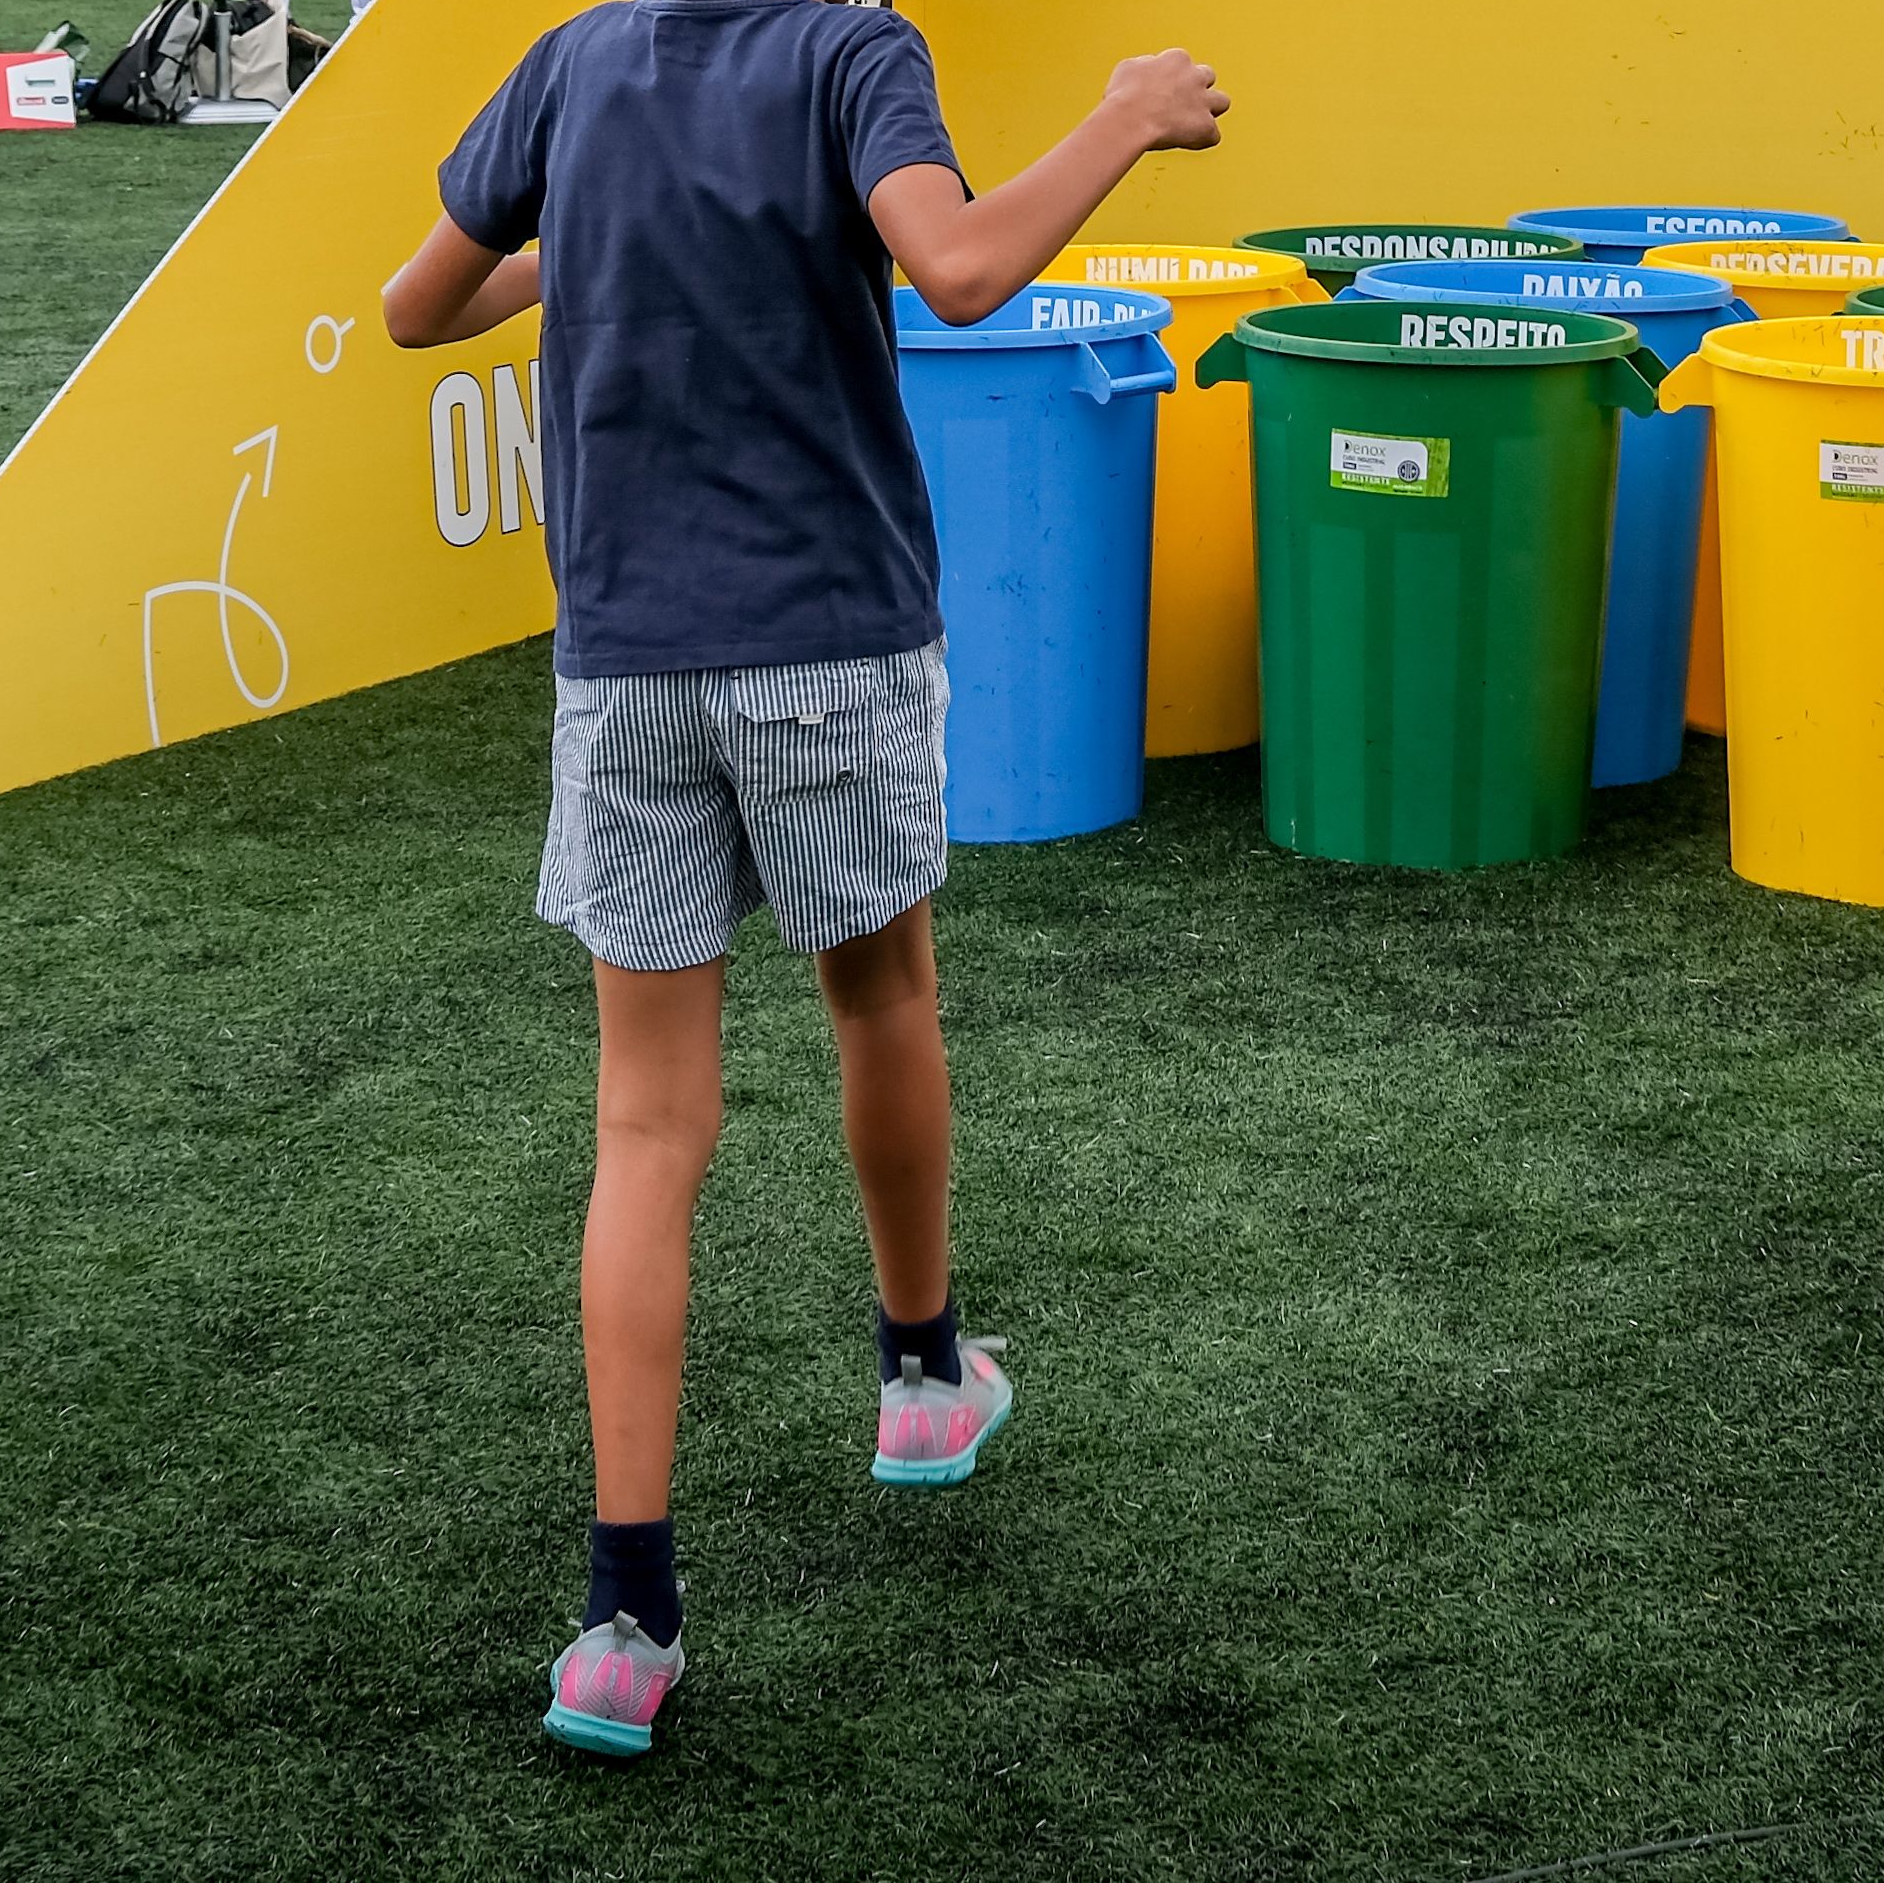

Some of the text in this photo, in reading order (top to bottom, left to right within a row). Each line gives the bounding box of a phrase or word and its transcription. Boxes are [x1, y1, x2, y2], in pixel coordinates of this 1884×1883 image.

[1305, 235, 1560, 259] RESPONSABIL
[1086, 257, 1259, 281] HUMILDA
[1032, 297, 1153, 330] FAIR-P
[1400, 314, 1567, 349] RESPEITO
[430, 359, 546, 547] ON
[1343, 439, 1386, 456] Denox
[1832, 449, 1878, 466] Denox
